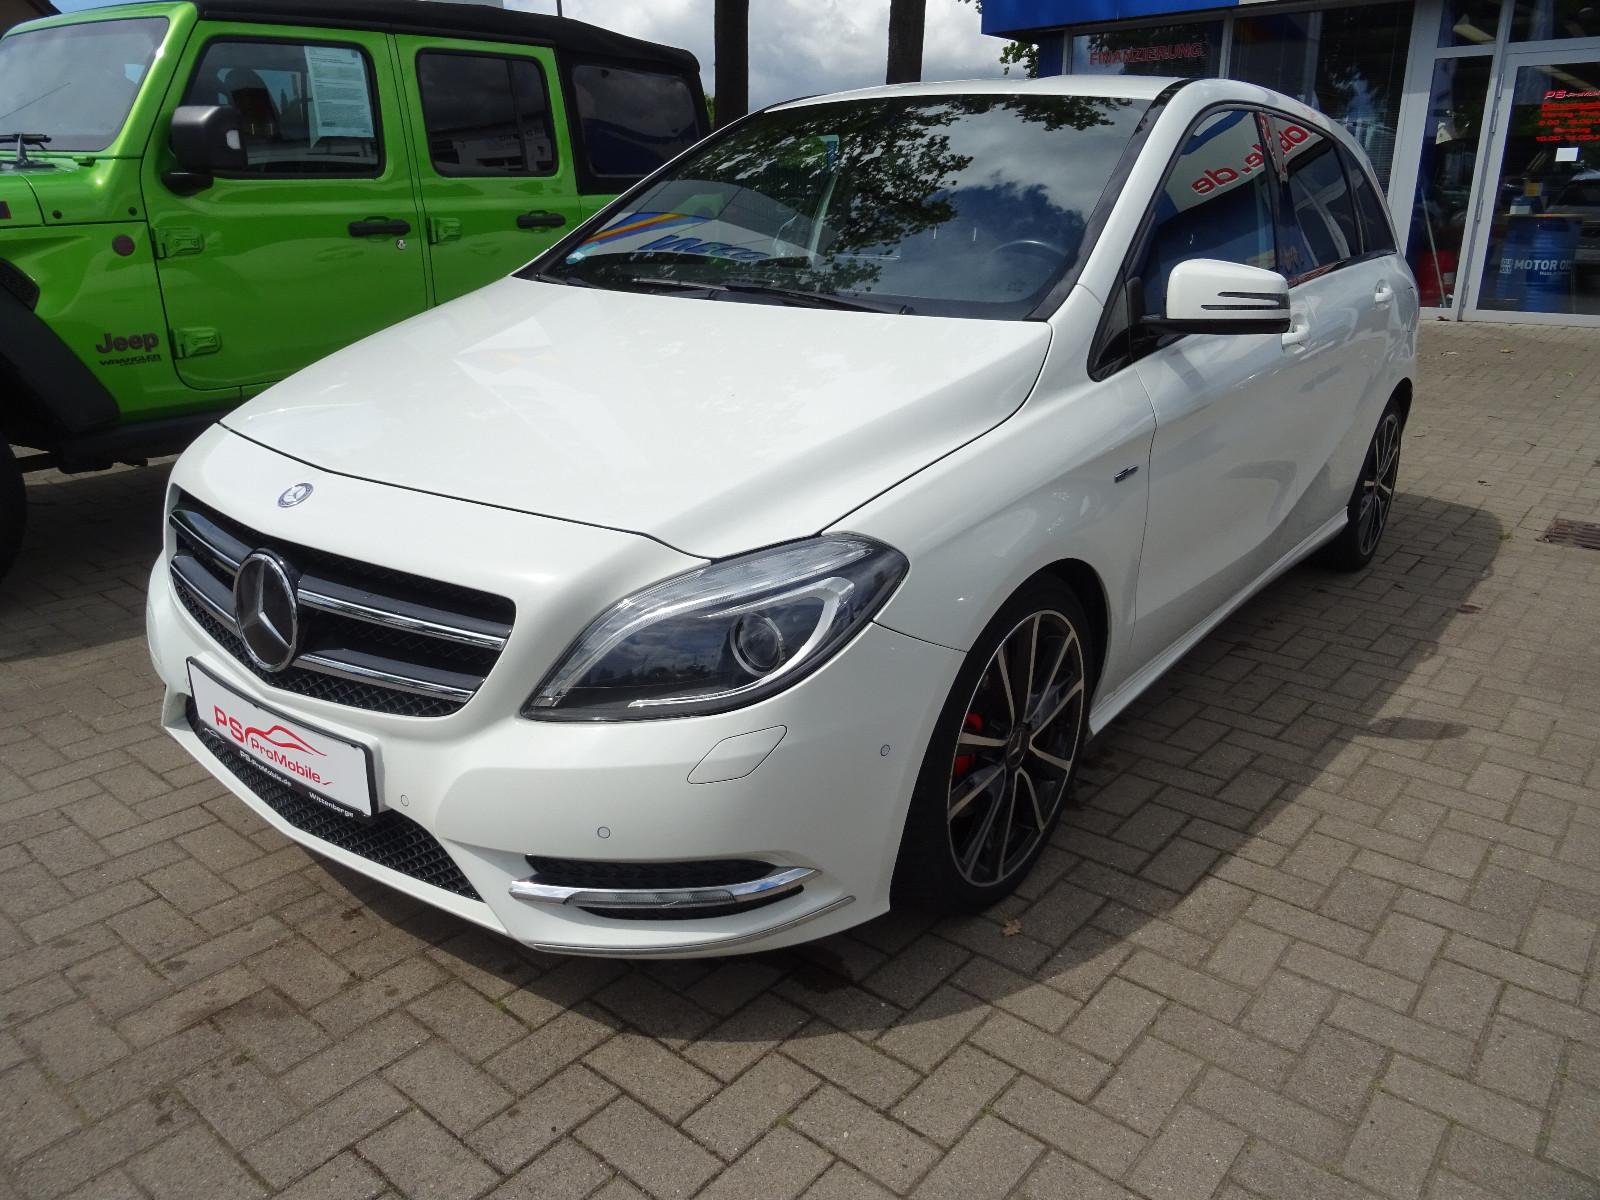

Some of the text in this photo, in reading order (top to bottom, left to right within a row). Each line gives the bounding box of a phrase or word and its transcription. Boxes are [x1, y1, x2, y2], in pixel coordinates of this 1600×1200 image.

[1089, 42, 1202, 65] FINANZIERUNG
[1513, 259, 1558, 271] MOTOR
[95, 332, 159, 353] Jeep
[214, 704, 322, 784] PS ProMobile
[308, 791, 354, 818] Wittenberge
